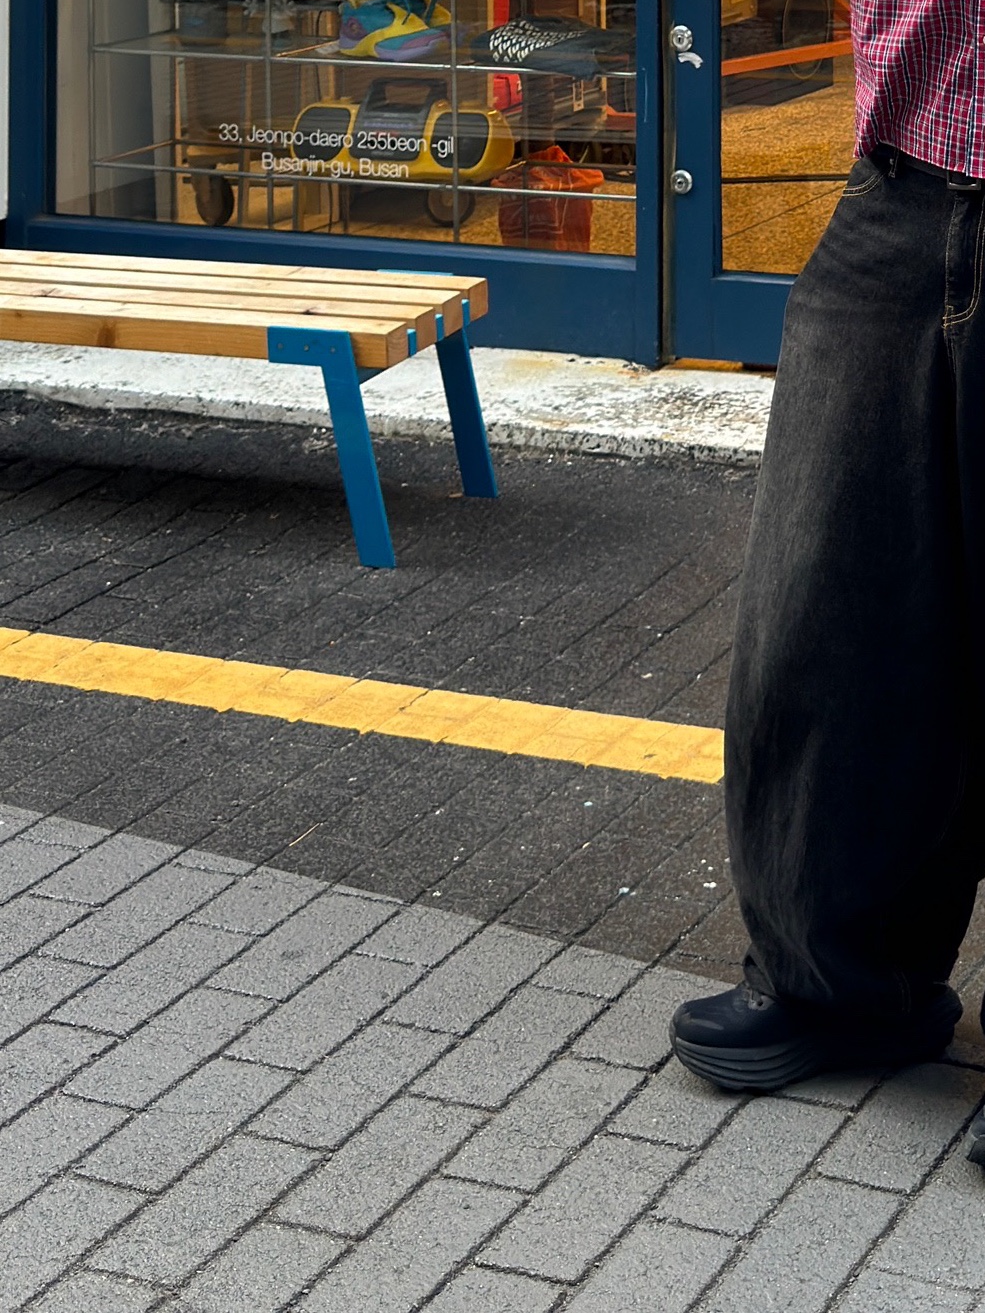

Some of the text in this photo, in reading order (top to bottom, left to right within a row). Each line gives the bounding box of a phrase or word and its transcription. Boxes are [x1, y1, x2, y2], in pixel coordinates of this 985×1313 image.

[218, 123, 243, 144] 33,
[247, 125, 352, 149] Jeonpo-daero
[357, 130, 427, 153] 255beon
[261, 151, 409, 179] Busanjin-gu, Busan
